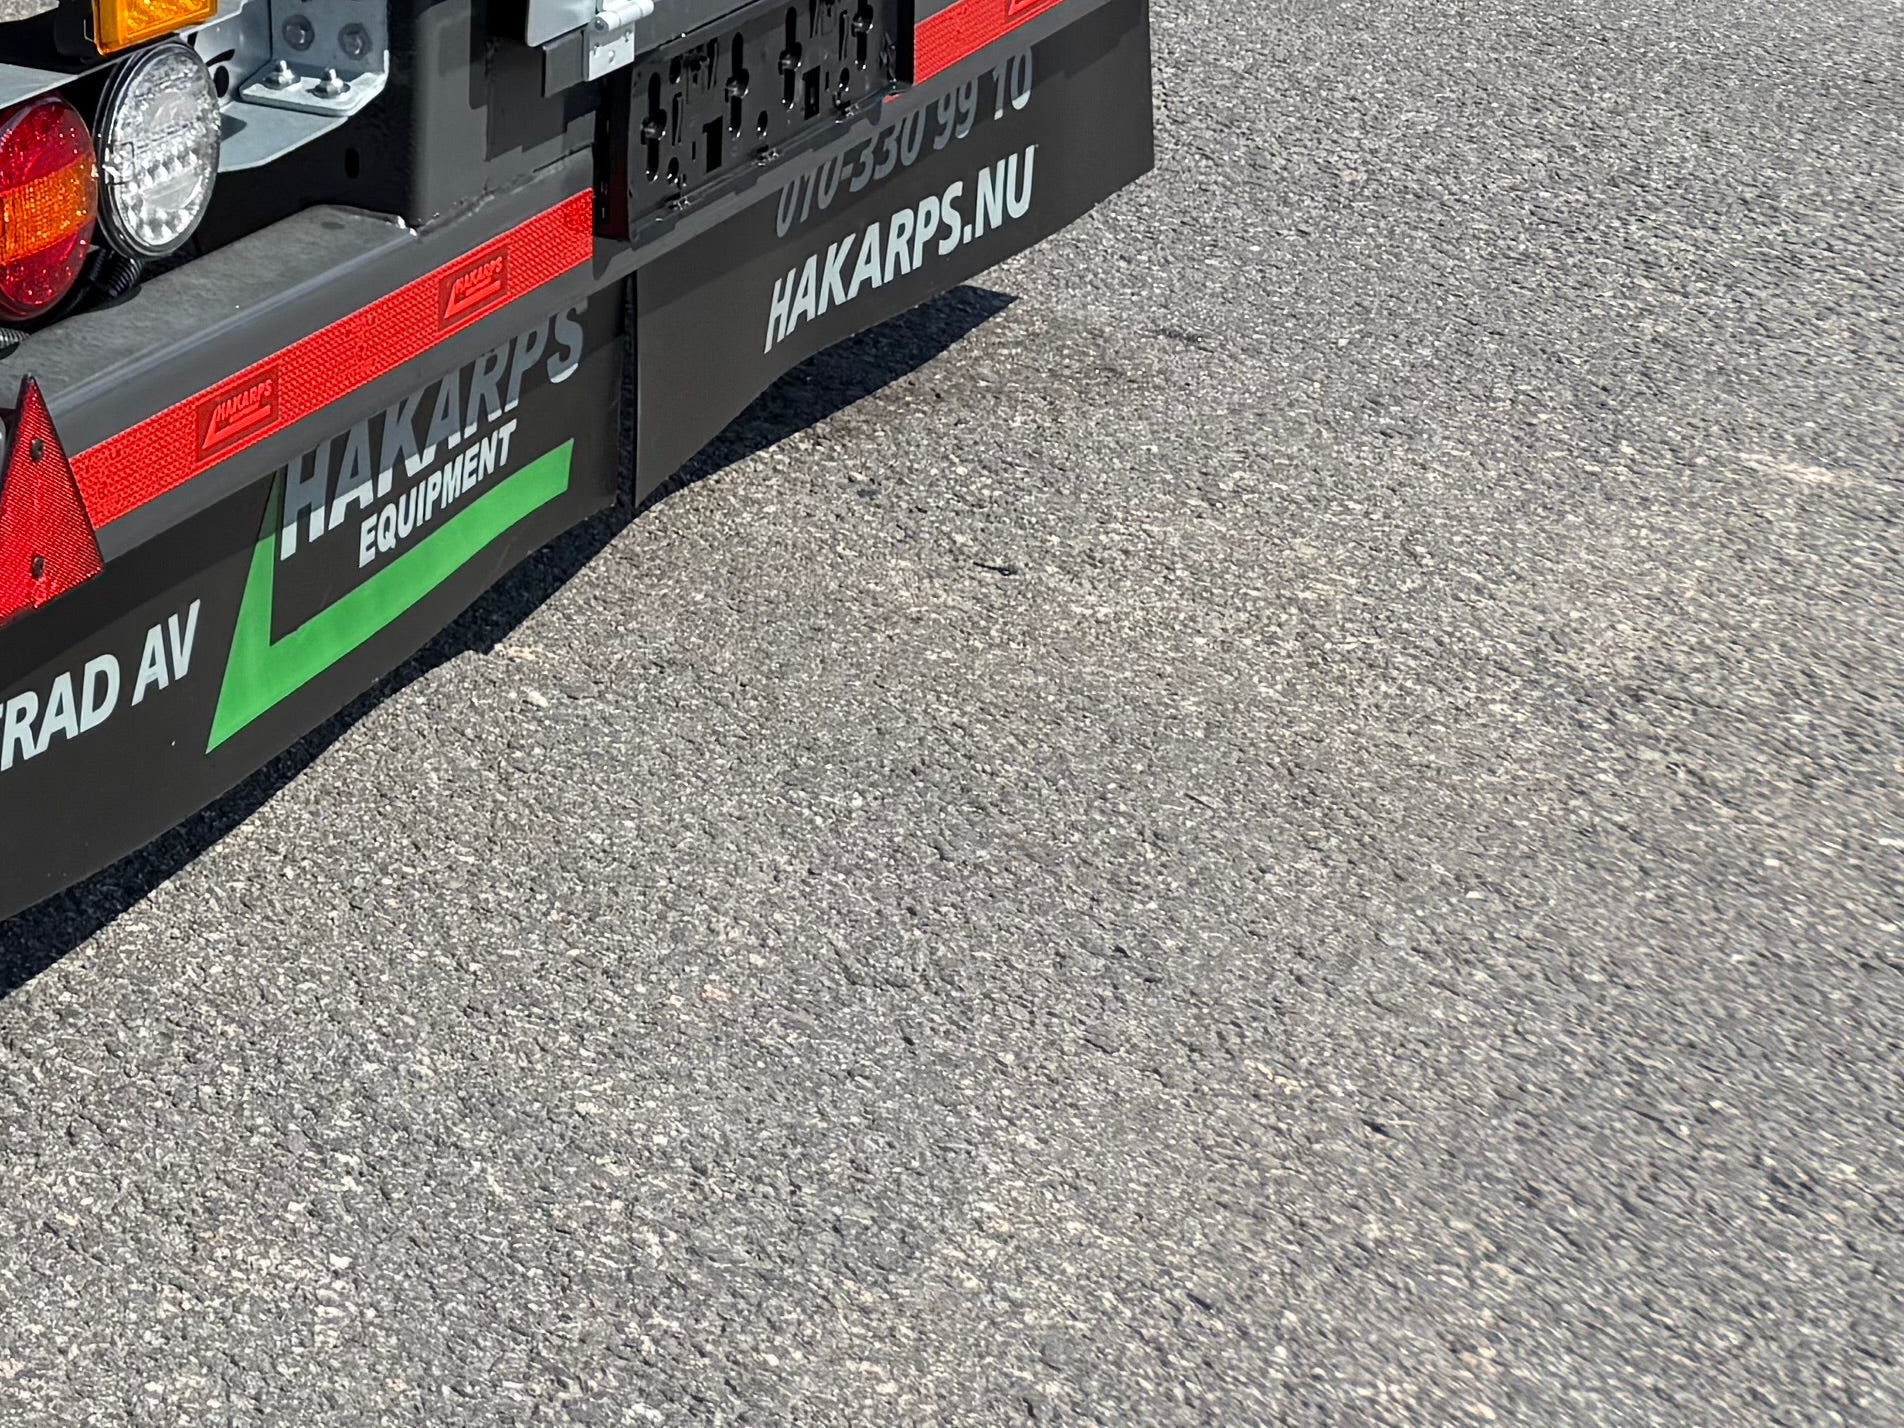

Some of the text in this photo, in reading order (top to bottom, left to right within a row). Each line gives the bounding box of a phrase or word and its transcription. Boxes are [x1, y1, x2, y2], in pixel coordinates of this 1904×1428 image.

[763, 144, 1036, 355] HAKARPS.NU
[215, 378, 273, 422] HAKARPS
[279, 294, 590, 561] HAKARPS
[358, 417, 518, 569] EQUIPMENT
[131, 598, 201, 707] AV
